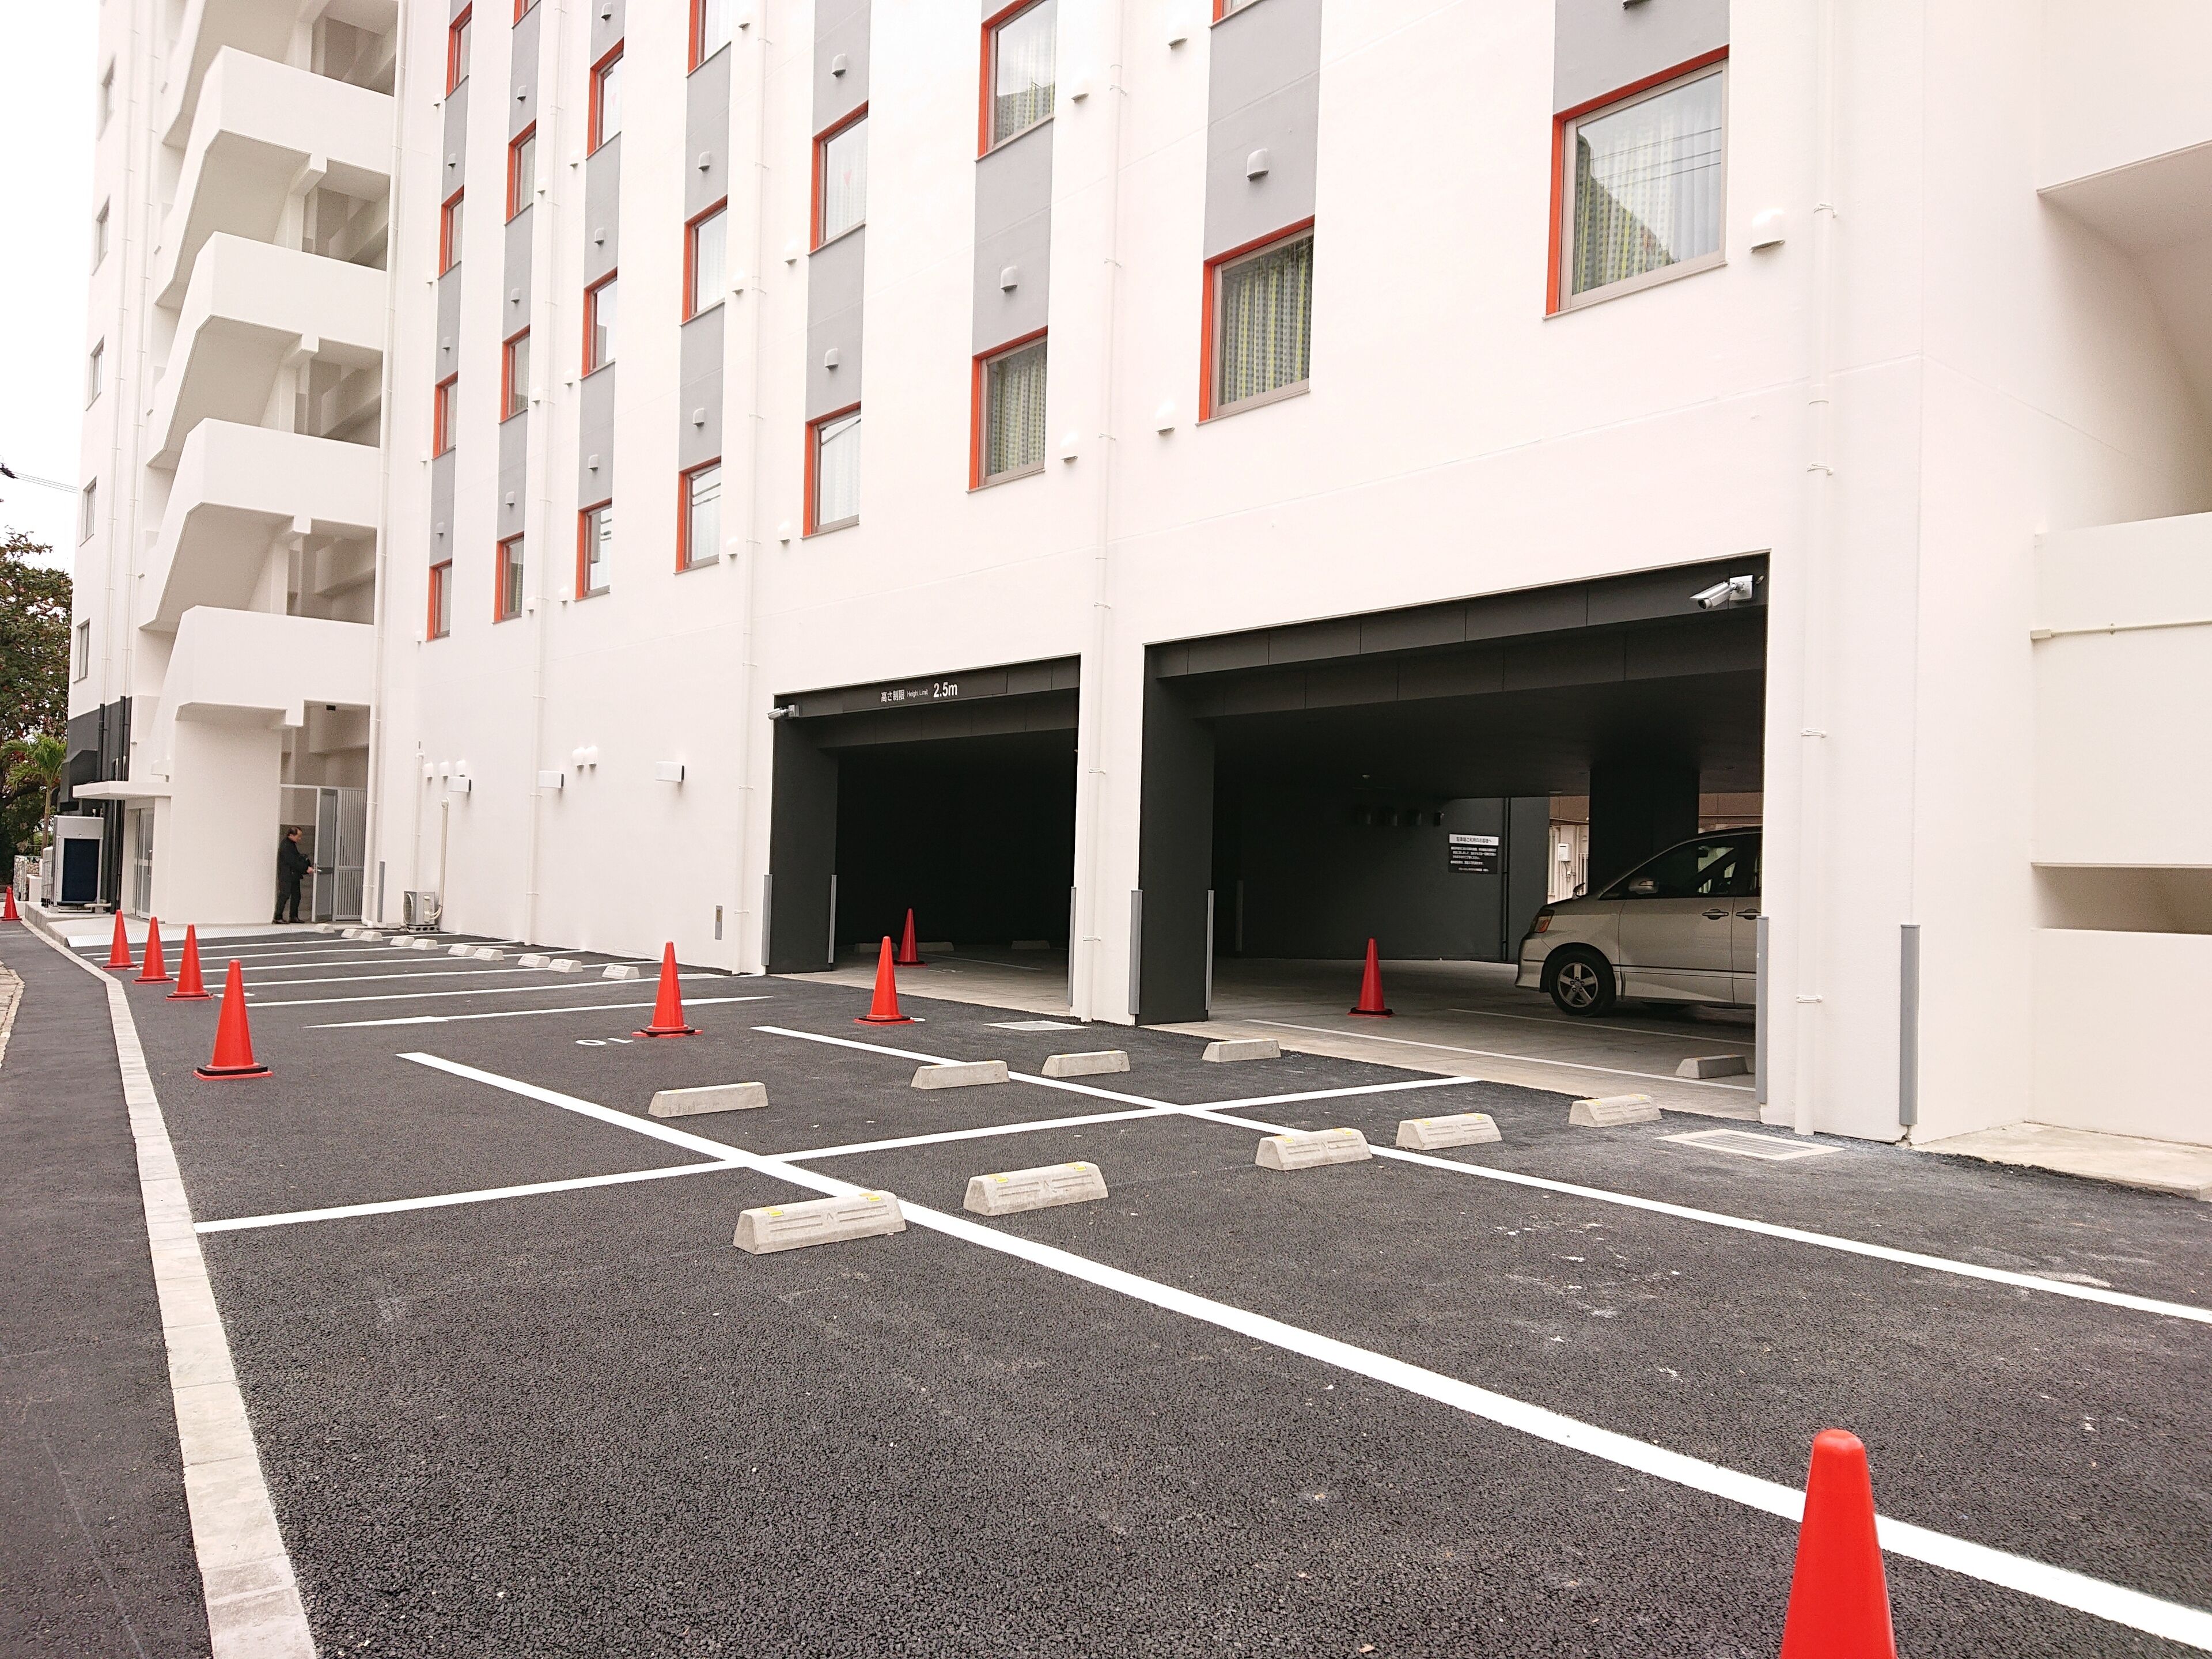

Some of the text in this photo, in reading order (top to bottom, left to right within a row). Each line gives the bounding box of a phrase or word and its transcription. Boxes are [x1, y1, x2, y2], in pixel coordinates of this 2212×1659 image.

[881, 690, 905, 703] 高さ制限
[933, 681, 958, 698] 2.5m
